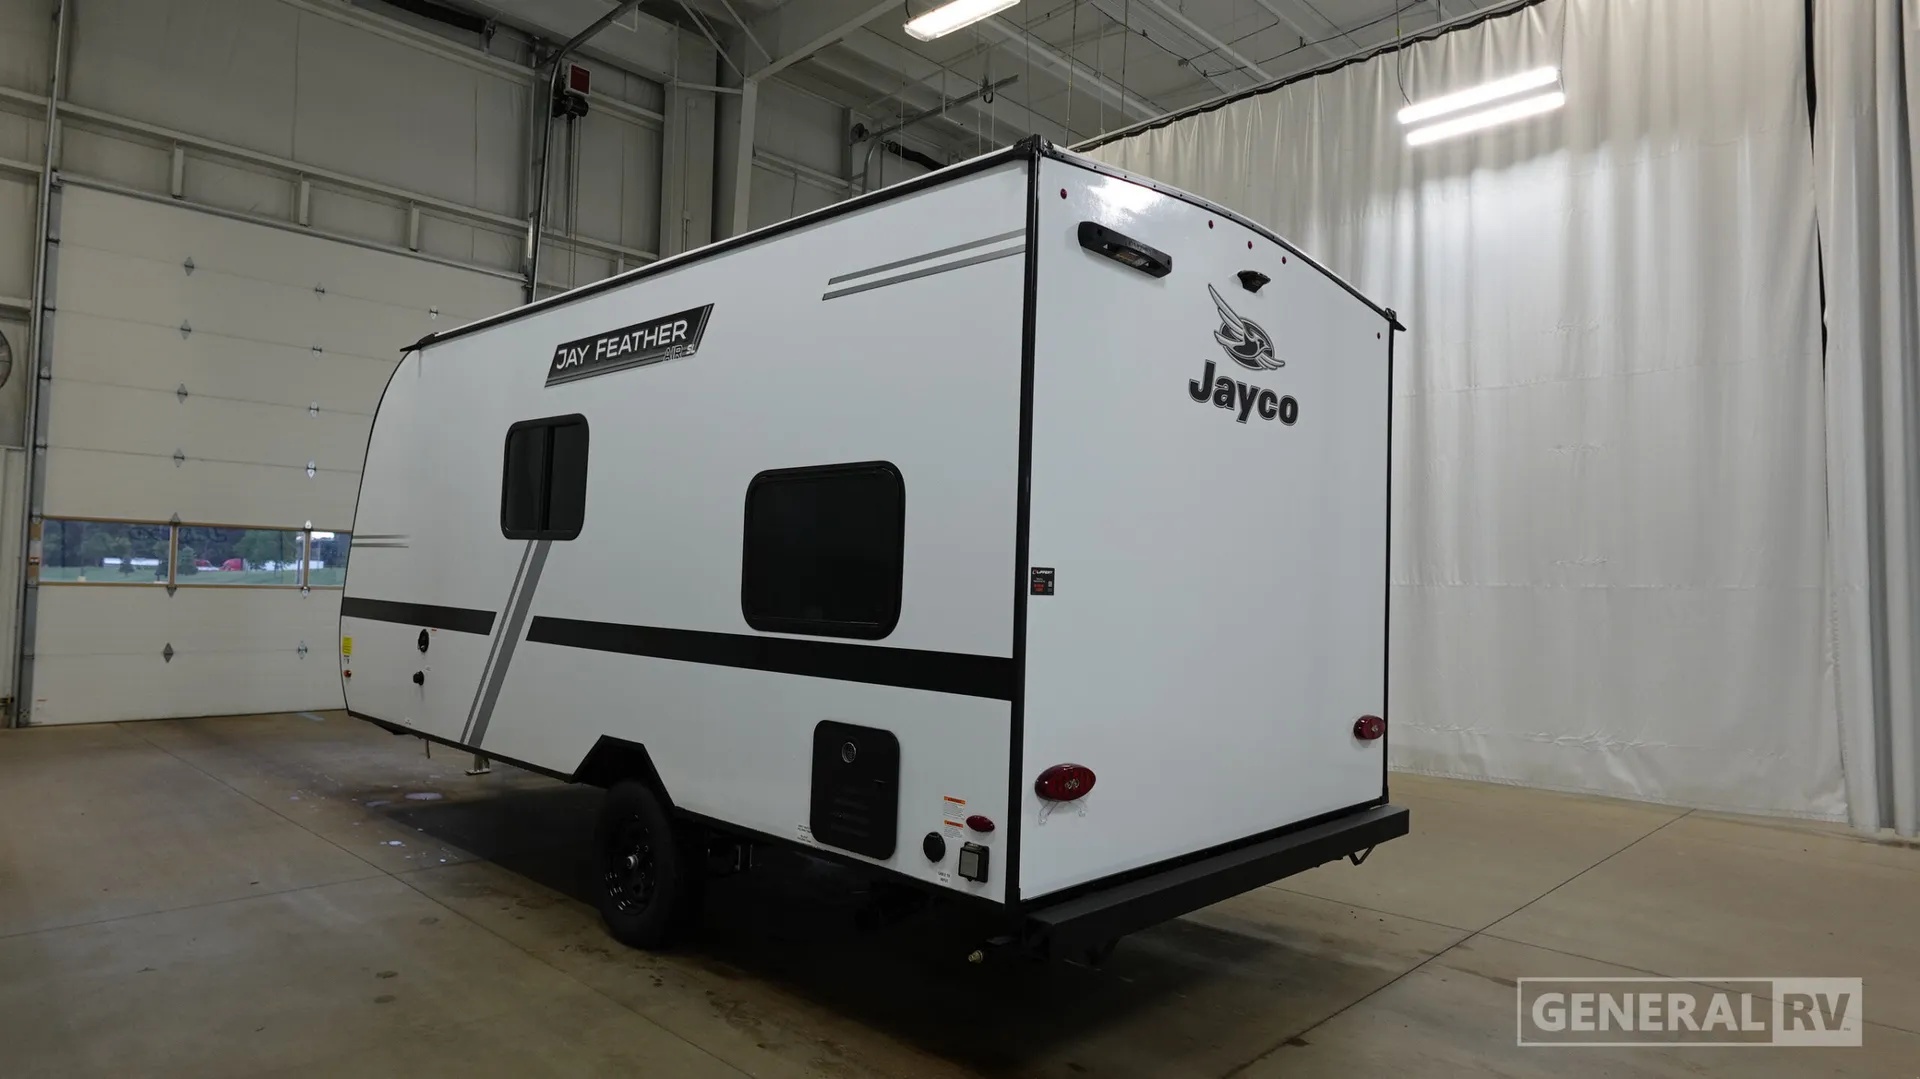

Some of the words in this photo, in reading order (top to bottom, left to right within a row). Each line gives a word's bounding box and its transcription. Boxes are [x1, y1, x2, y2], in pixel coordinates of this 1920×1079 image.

[556, 345, 590, 369] JAY
[595, 320, 688, 360] FEATHER
[663, 345, 683, 361] AIR
[1188, 359, 1299, 426] Jayco
